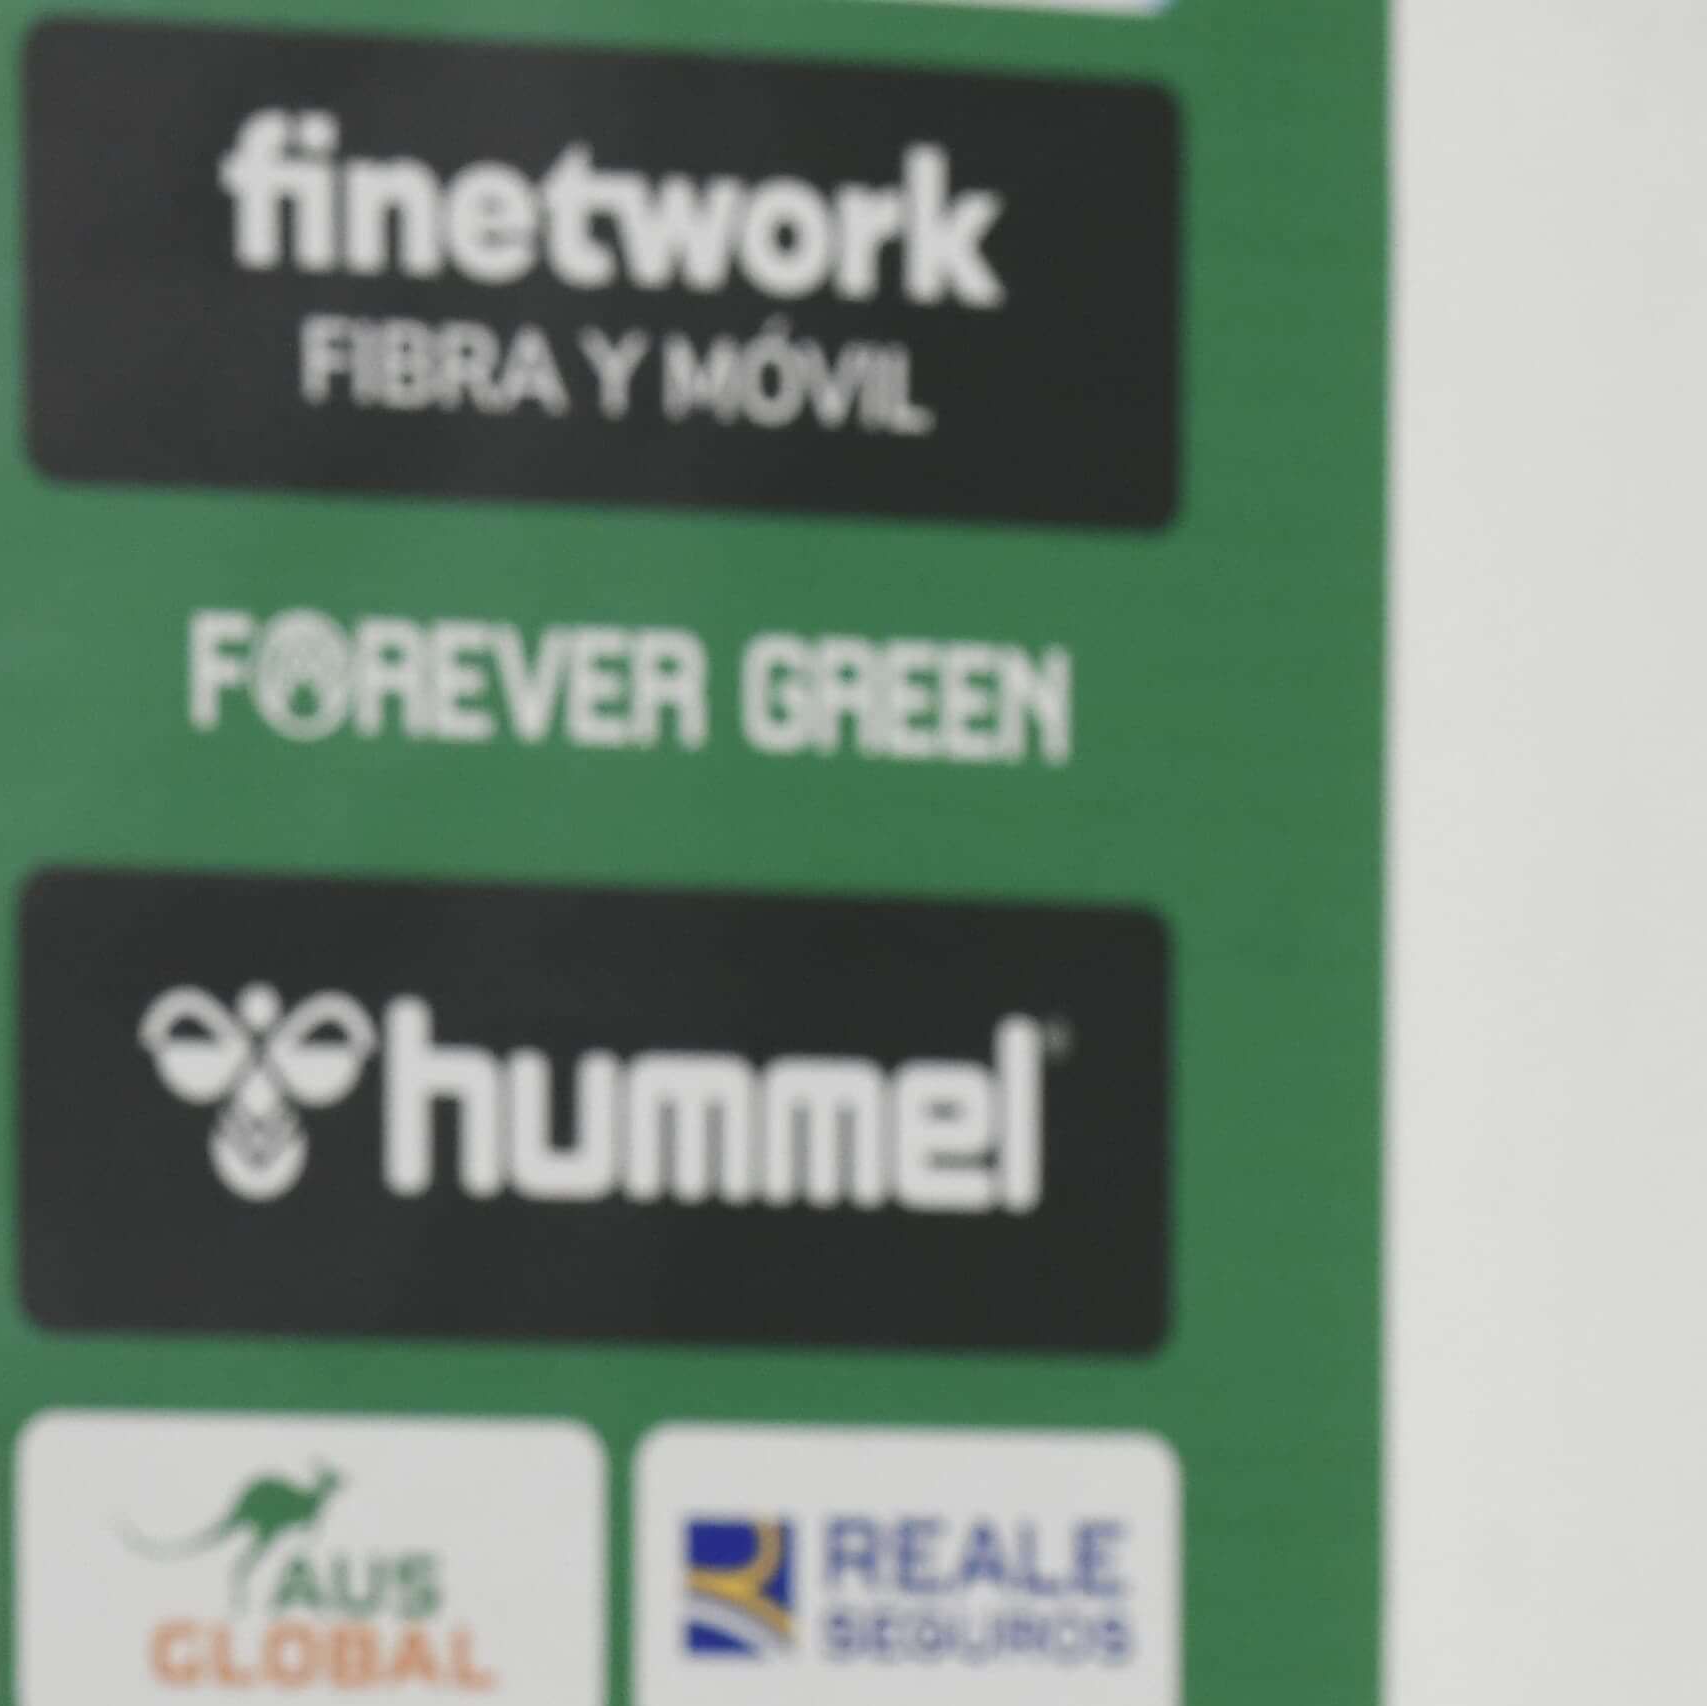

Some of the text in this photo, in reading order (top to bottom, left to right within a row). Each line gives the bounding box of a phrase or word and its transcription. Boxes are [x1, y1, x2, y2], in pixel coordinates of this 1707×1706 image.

[221, 110, 999, 305] finetwork
[301, 315, 930, 433] FIBRA Y MÓVIL
[189, 610, 1070, 762] FOREVER GREEN
[384, 997, 1044, 1211] hummel
[272, 1555, 441, 1616] AUS
[823, 1516, 1124, 1596] REALE
[150, 1622, 495, 1691] GLOBAL
[822, 1608, 1132, 1665] SEGUROS
